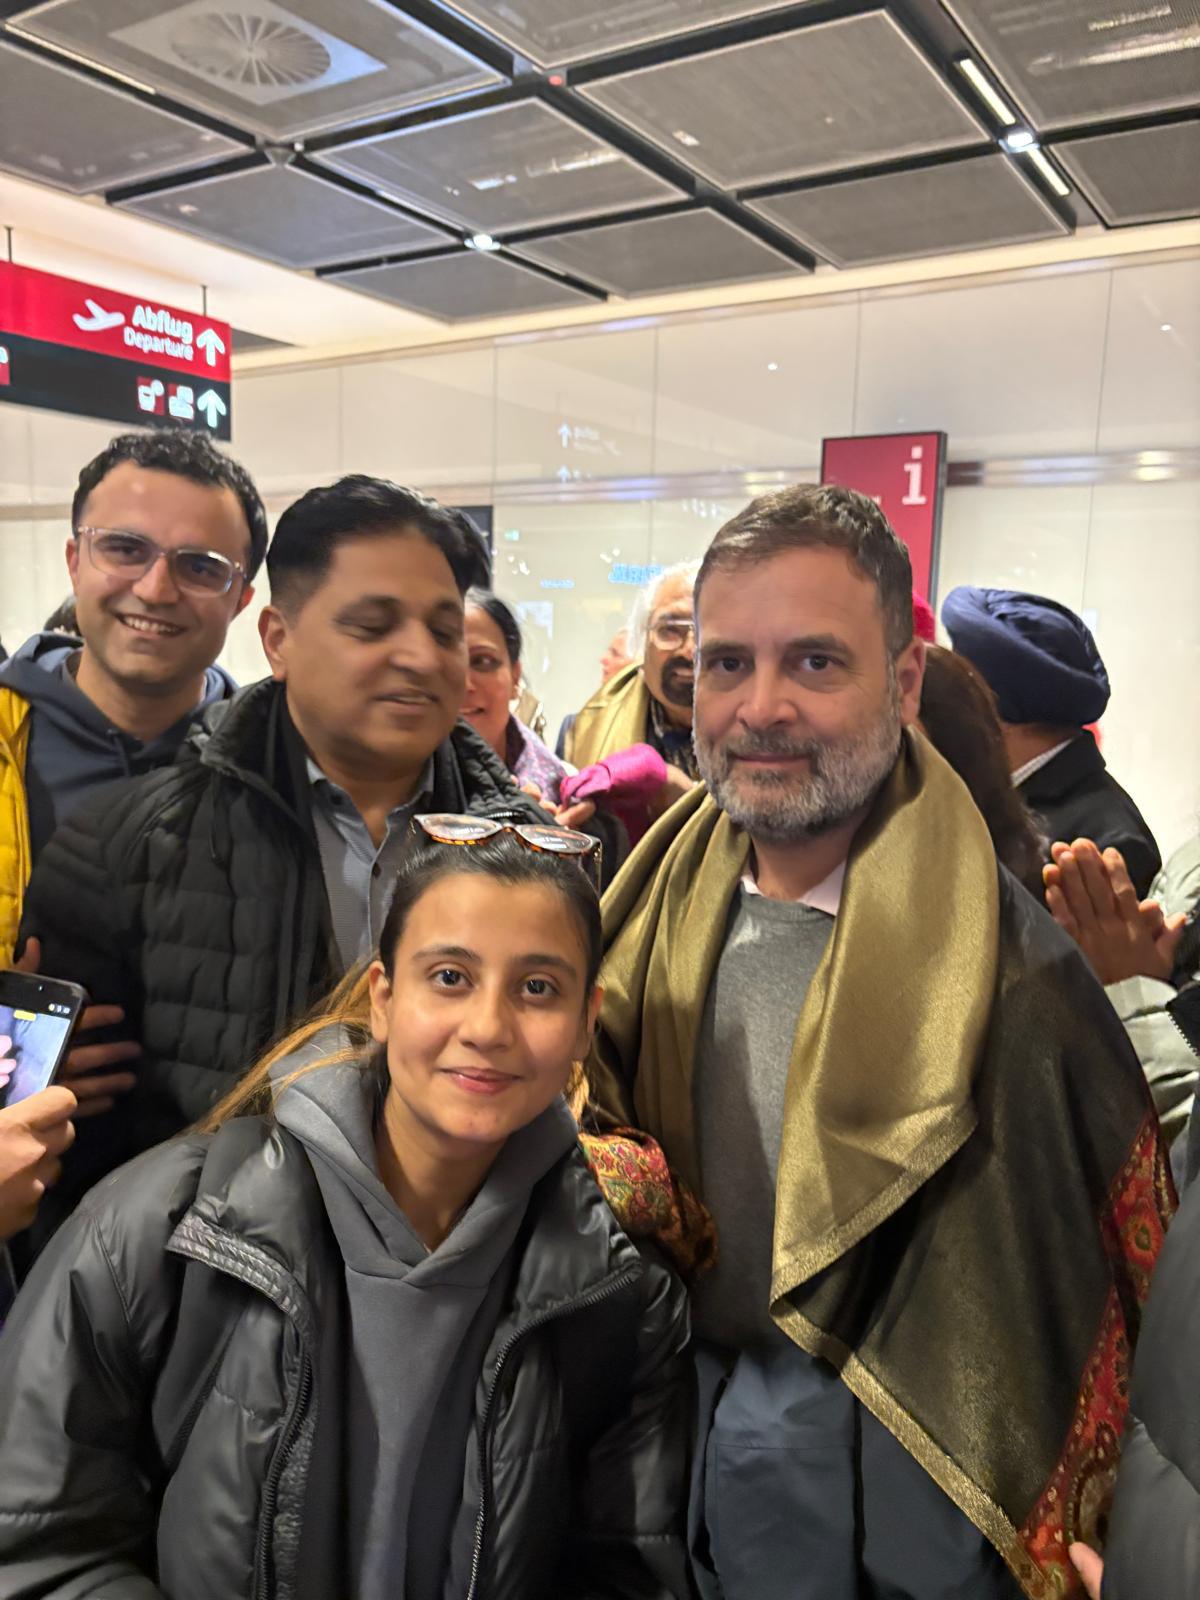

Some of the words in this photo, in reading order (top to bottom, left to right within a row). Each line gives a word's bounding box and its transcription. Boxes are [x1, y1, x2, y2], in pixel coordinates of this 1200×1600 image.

[123, 326, 194, 361] Departure
[132, 304, 193, 344] Abflug
[901, 446, 927, 505] i
